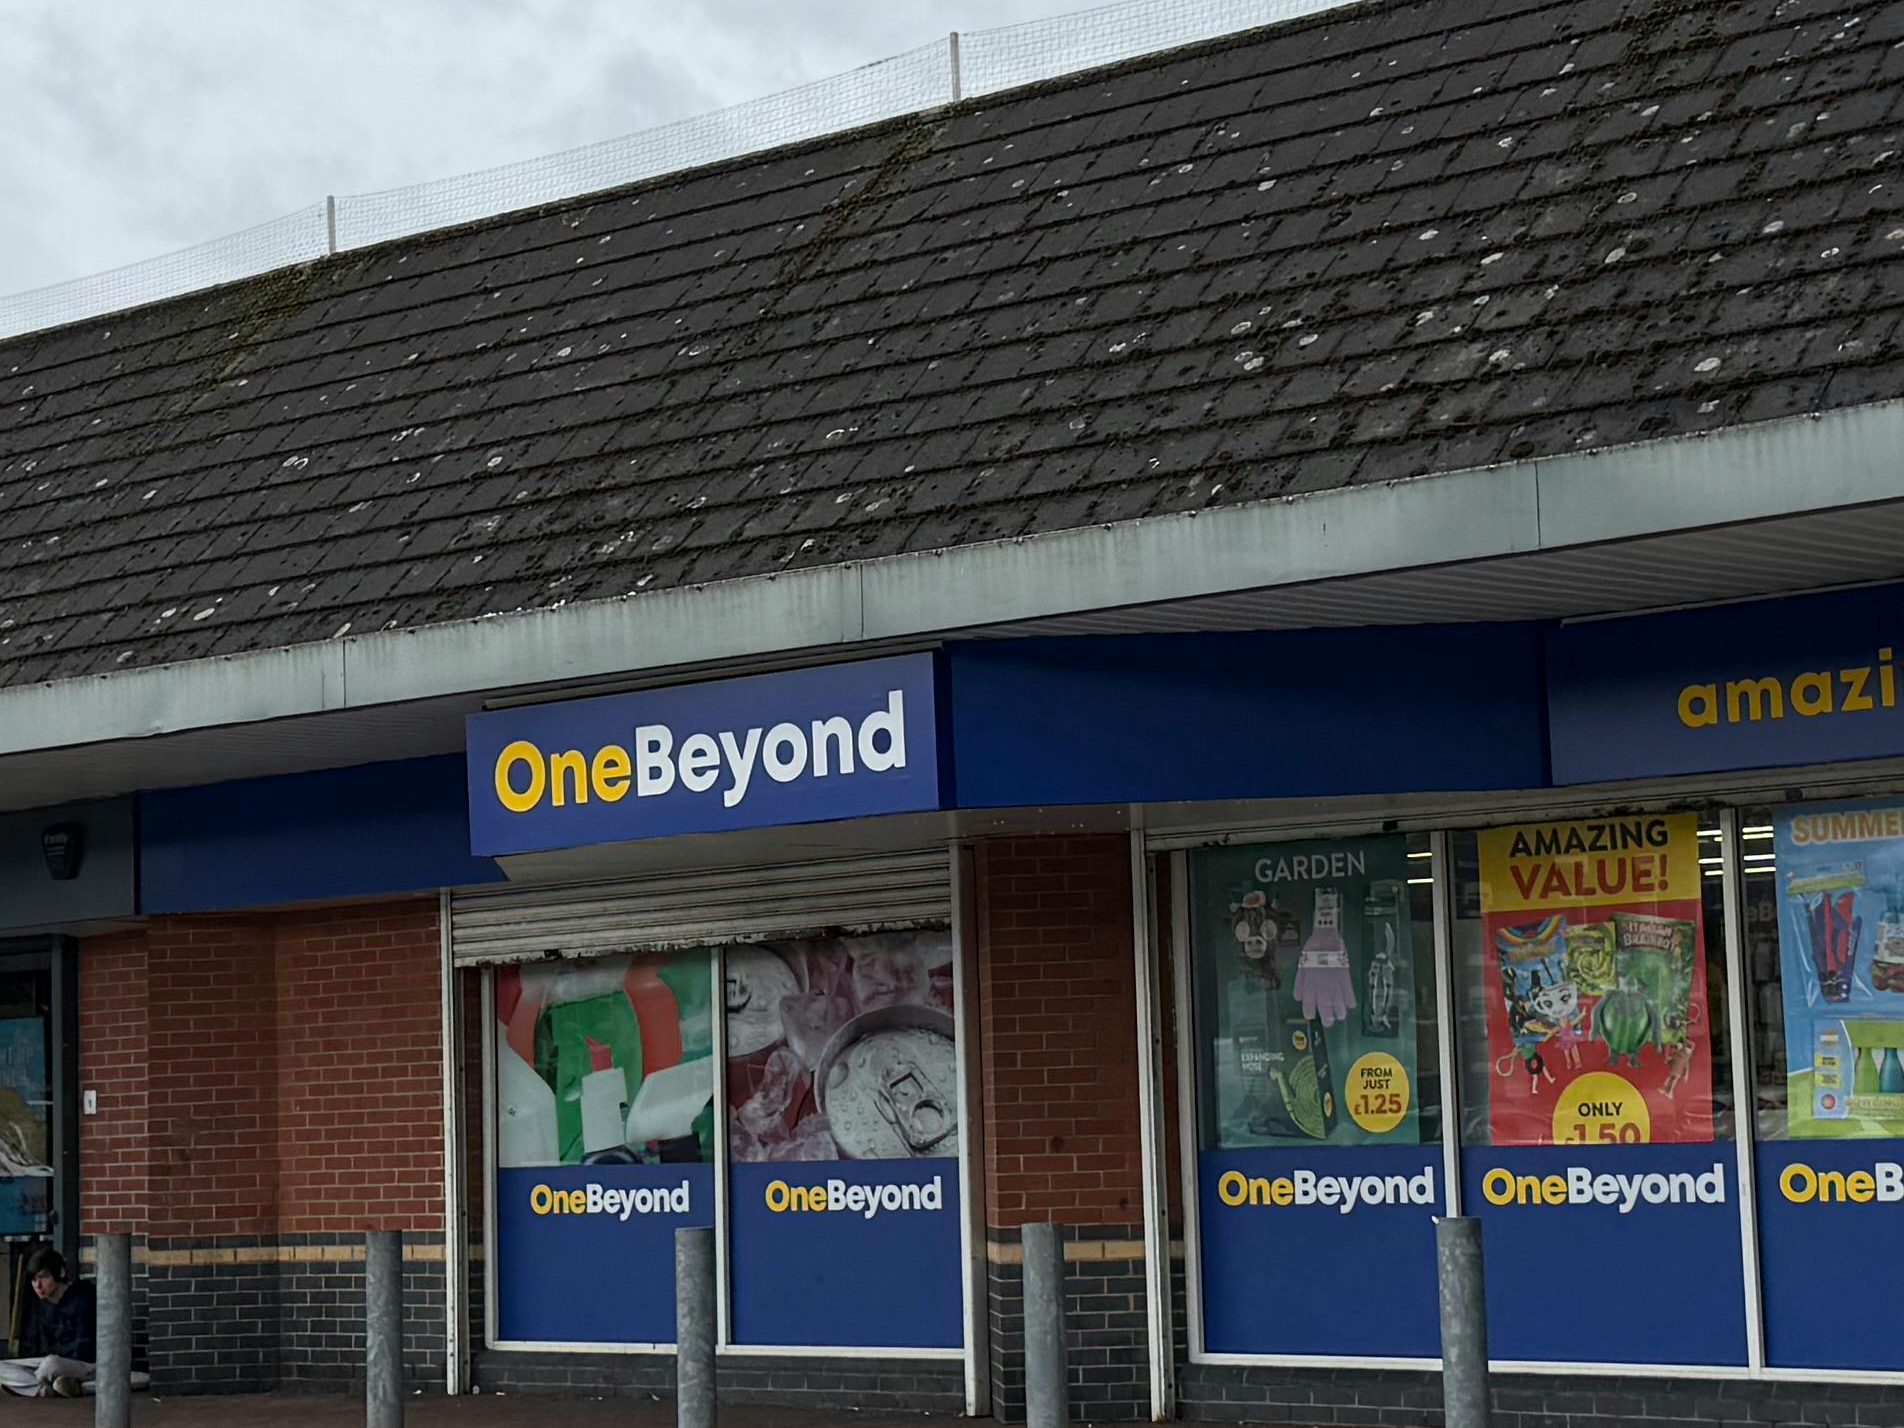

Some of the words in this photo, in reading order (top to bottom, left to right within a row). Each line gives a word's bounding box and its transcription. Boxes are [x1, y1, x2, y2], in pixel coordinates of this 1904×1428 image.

[494, 690, 907, 812] OneBeyond
[1509, 820, 1668, 858] AMAZING
[1255, 851, 1365, 883] GARDEN
[1510, 854, 1668, 900] VALUE!
[1360, 1067, 1393, 1079] FROM
[1362, 1078, 1391, 1090] JUST
[1354, 1094, 1402, 1115] £1.25
[1578, 1102, 1623, 1117] ONLY
[530, 1180, 690, 1221] OneBeyond
[764, 1176, 943, 1219] OneBeyond
[1218, 1166, 1435, 1214] OneBeyond
[1482, 1163, 1724, 1213] OneBeyond
